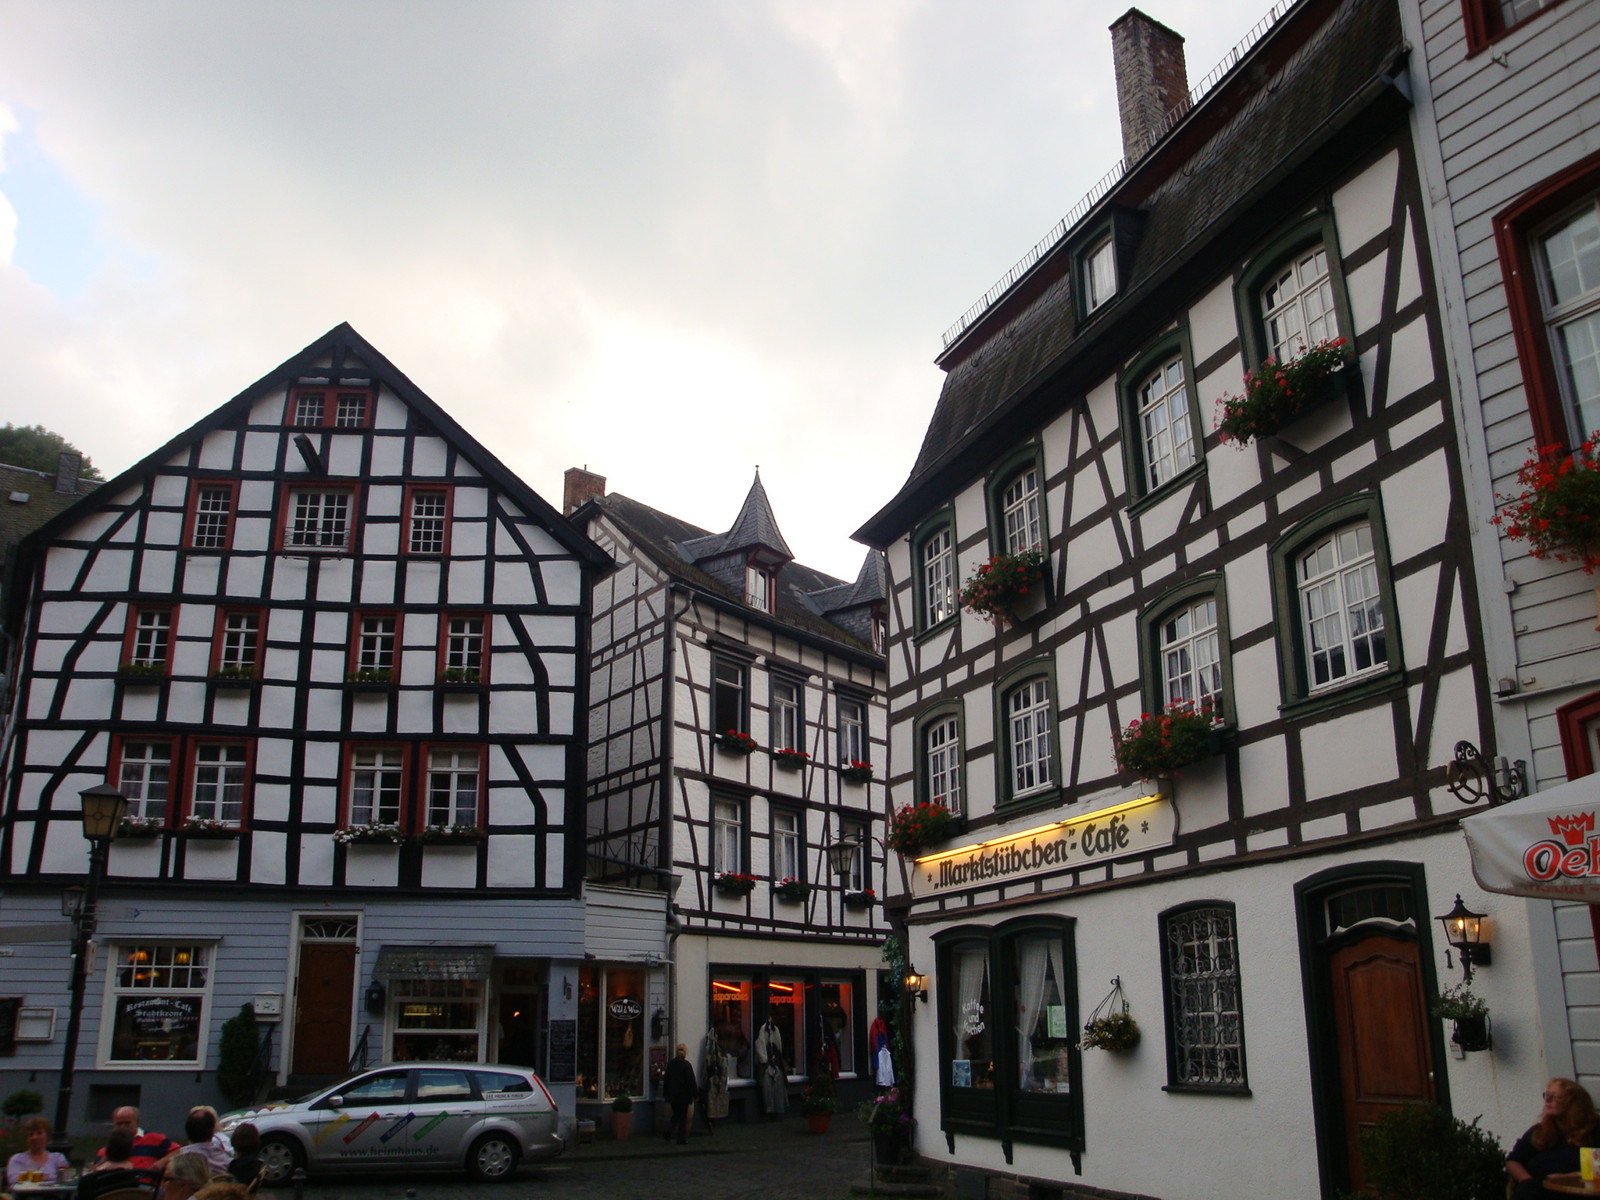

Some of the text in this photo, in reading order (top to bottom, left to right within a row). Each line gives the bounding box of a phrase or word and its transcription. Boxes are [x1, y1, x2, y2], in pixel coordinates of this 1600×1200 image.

[1444, 948, 1454, 969] 1
[962, 998, 984, 1014] Kaffee
[968, 1012, 979, 1022] und
[340, 1144, 440, 1157] www.heimhaus.de
